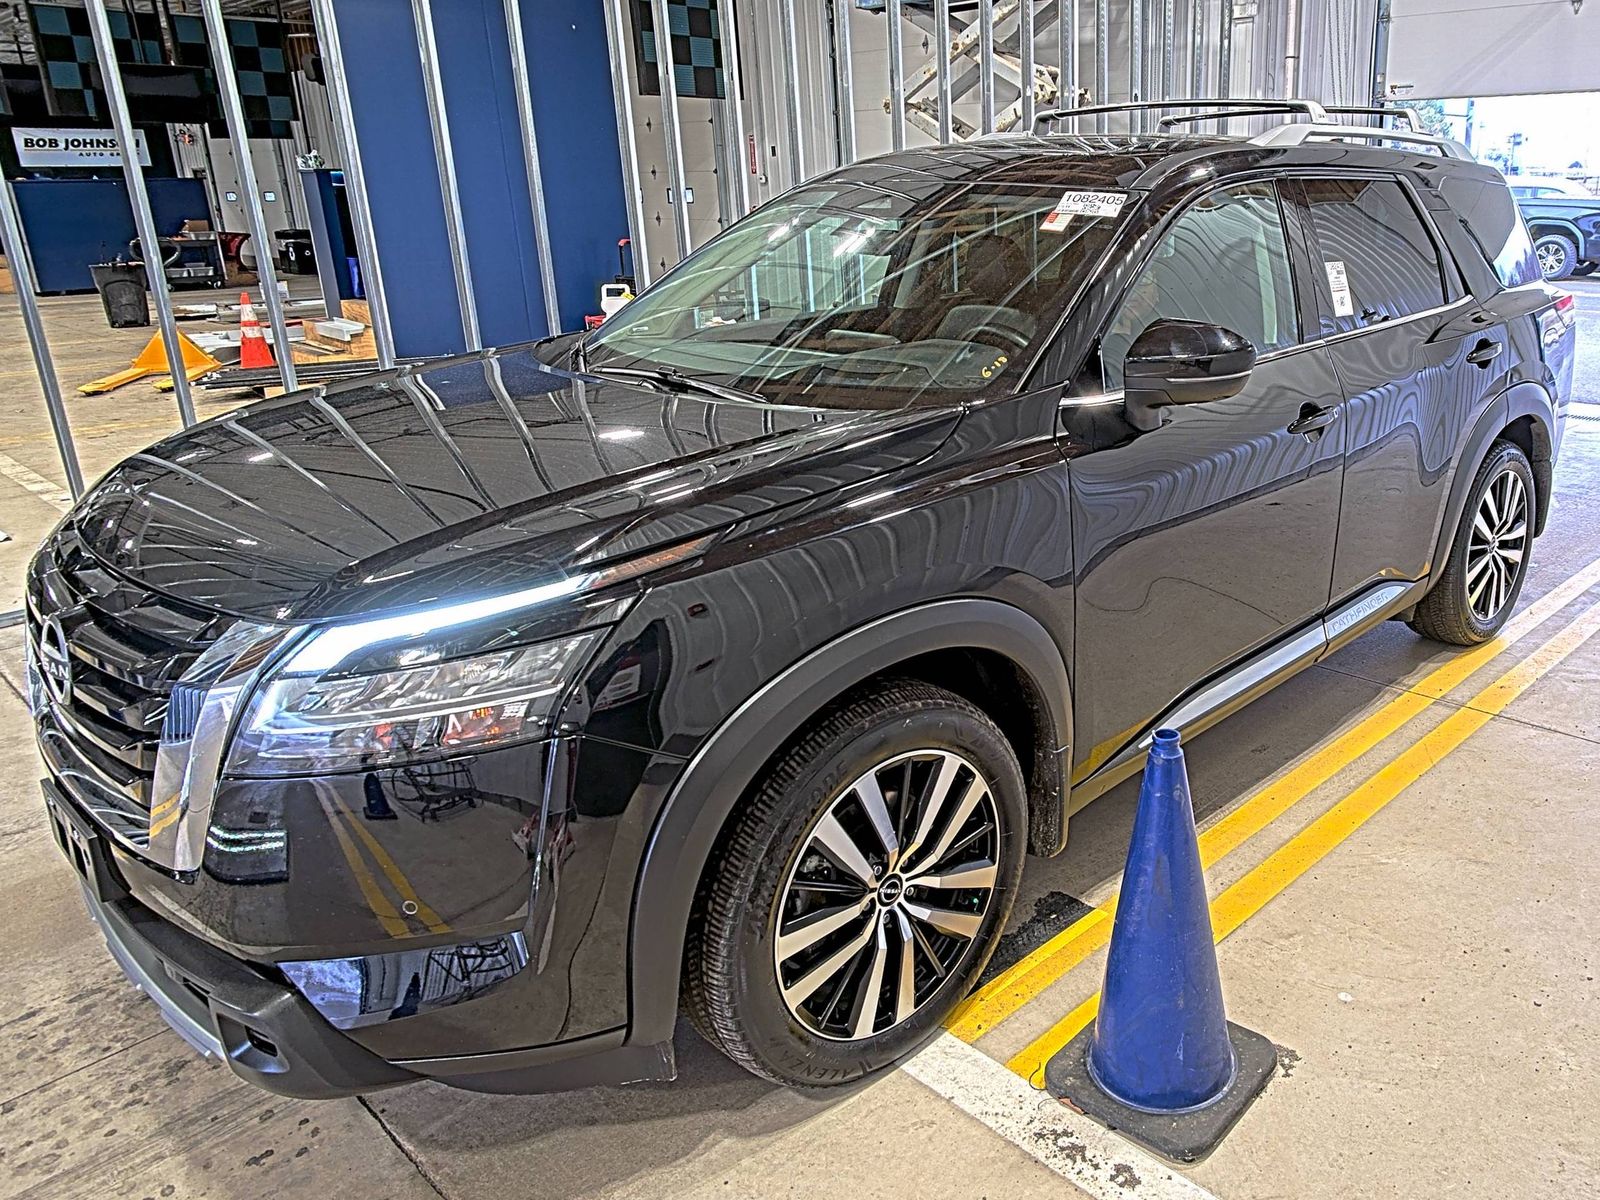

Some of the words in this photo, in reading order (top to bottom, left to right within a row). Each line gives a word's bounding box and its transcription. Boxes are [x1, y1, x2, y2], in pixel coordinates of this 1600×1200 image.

[24, 138, 59, 148] BOB
[63, 138, 140, 151] JOHNS
[1066, 193, 1125, 206] 1082405
[1331, 591, 1389, 632] PATHFINDER
